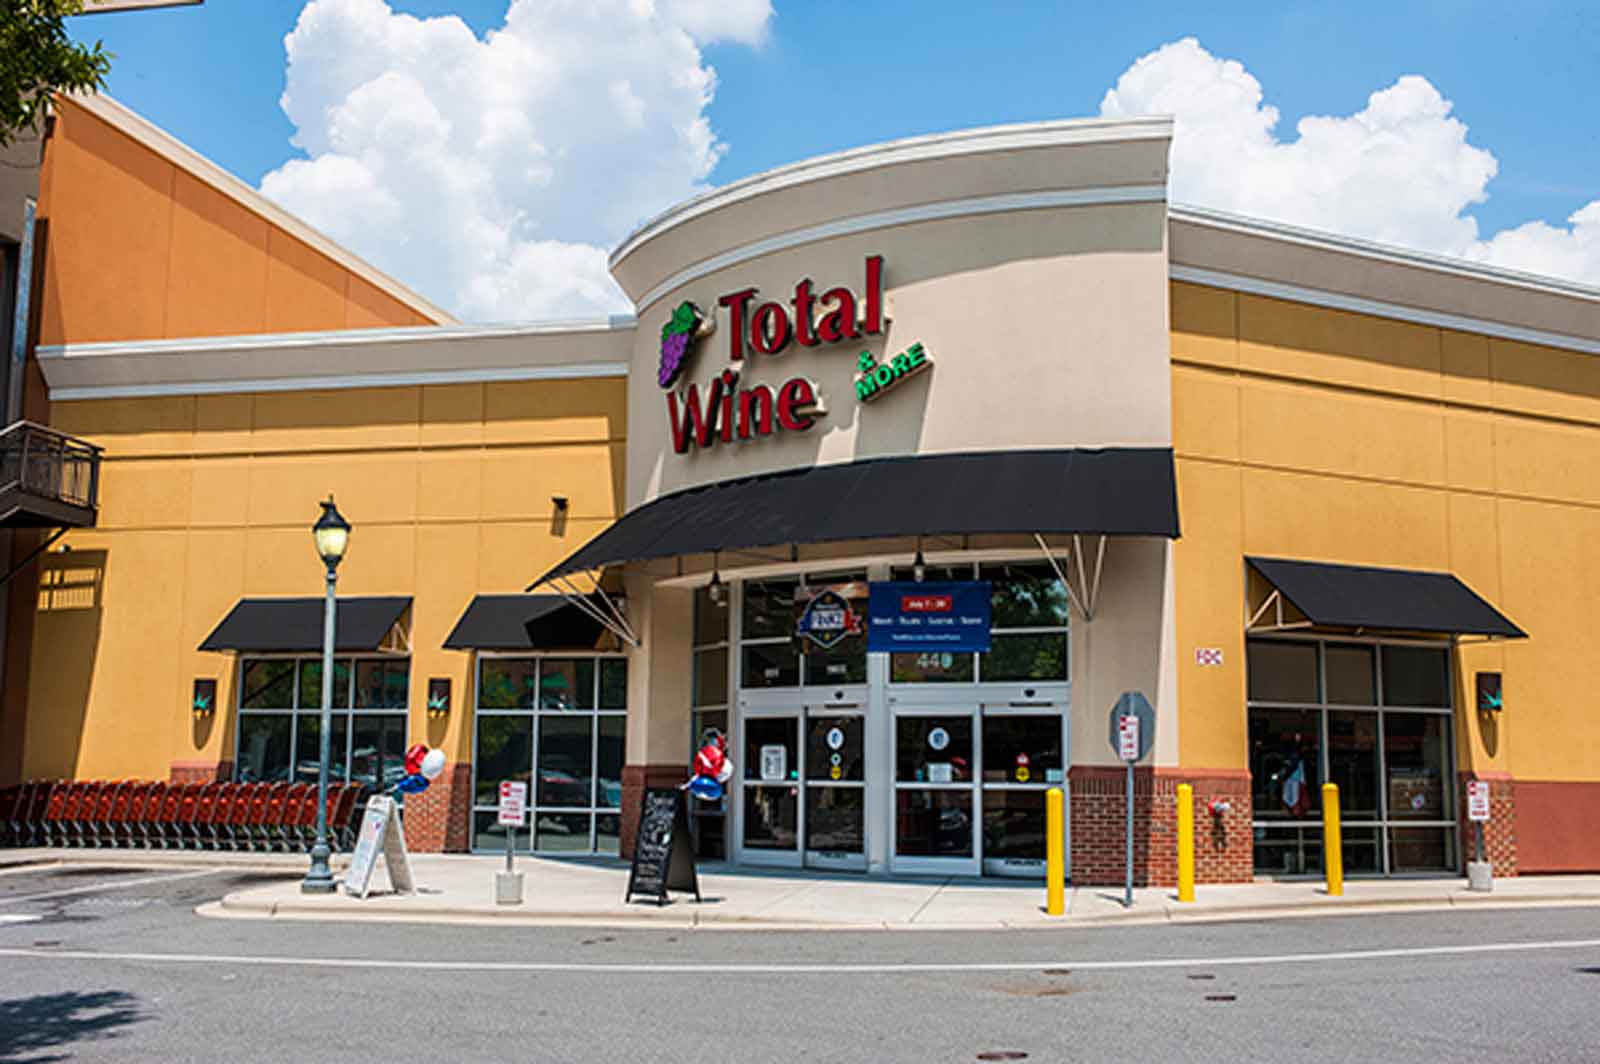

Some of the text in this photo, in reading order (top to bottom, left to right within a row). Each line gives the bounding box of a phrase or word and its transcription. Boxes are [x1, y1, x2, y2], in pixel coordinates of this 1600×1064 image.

[718, 254, 883, 361] Total
[855, 342, 927, 401] MORE
[857, 350, 876, 372] &
[666, 368, 819, 454] Wine
